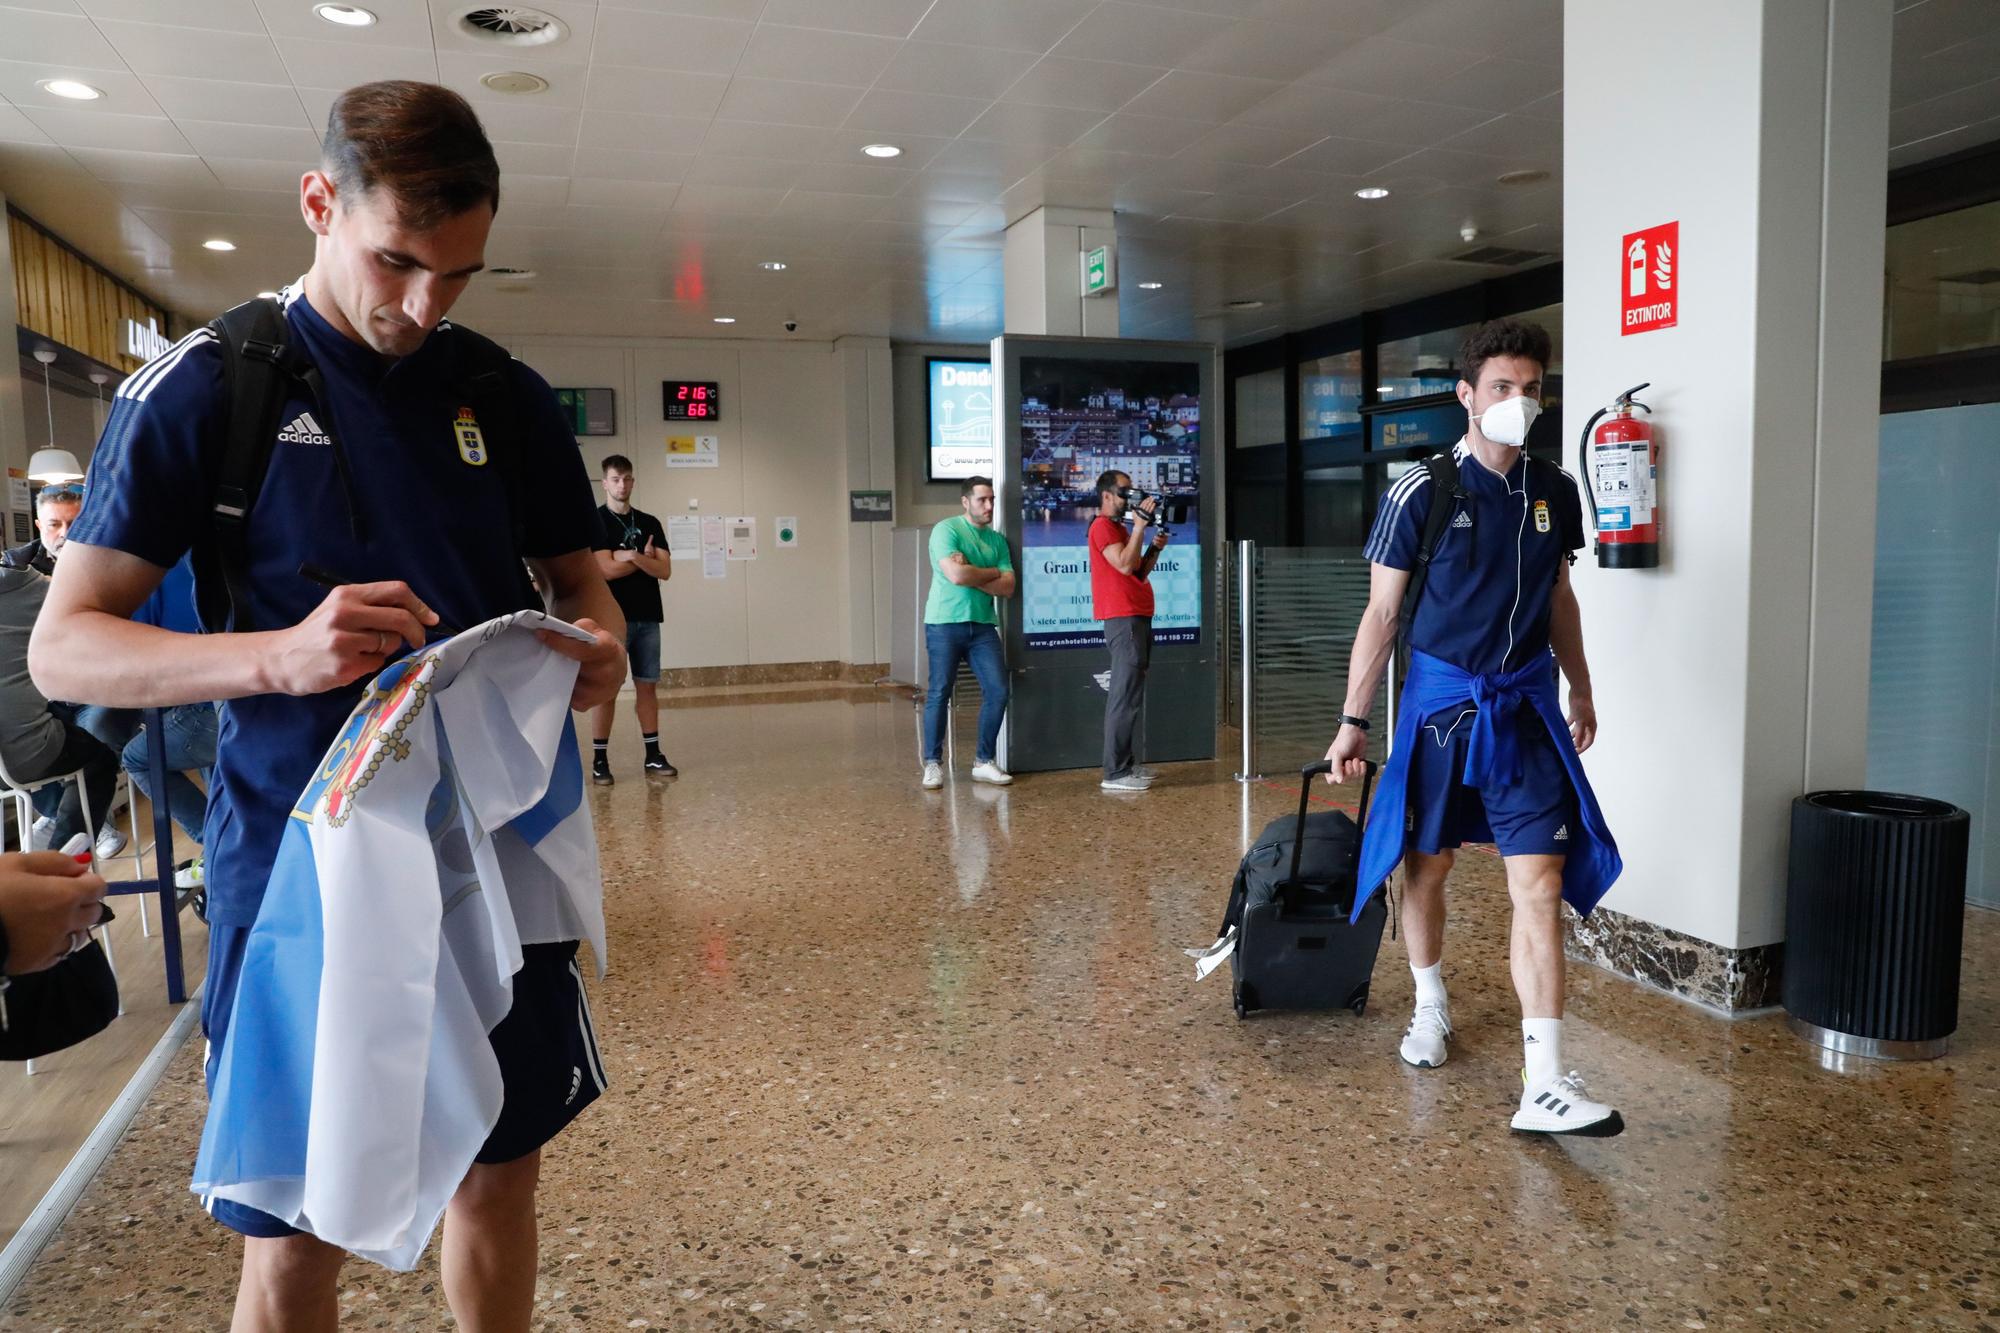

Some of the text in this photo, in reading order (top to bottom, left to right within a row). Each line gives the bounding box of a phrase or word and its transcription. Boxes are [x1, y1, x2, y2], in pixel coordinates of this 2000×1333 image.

[1626, 302, 1672, 326] EXTINTOR
[128, 316, 176, 362] LAVAZ
[688, 403, 706, 417] 66
[278, 431, 331, 445] adidas
[1044, 561, 1078, 574] Gran
[1071, 595, 1092, 605] HOT
[1037, 617, 1057, 625] siete
[1059, 616, 1092, 625] minutos
[1164, 613, 1195, 621] Asturias
[1029, 637, 1107, 646] www.granhotelbrillan
